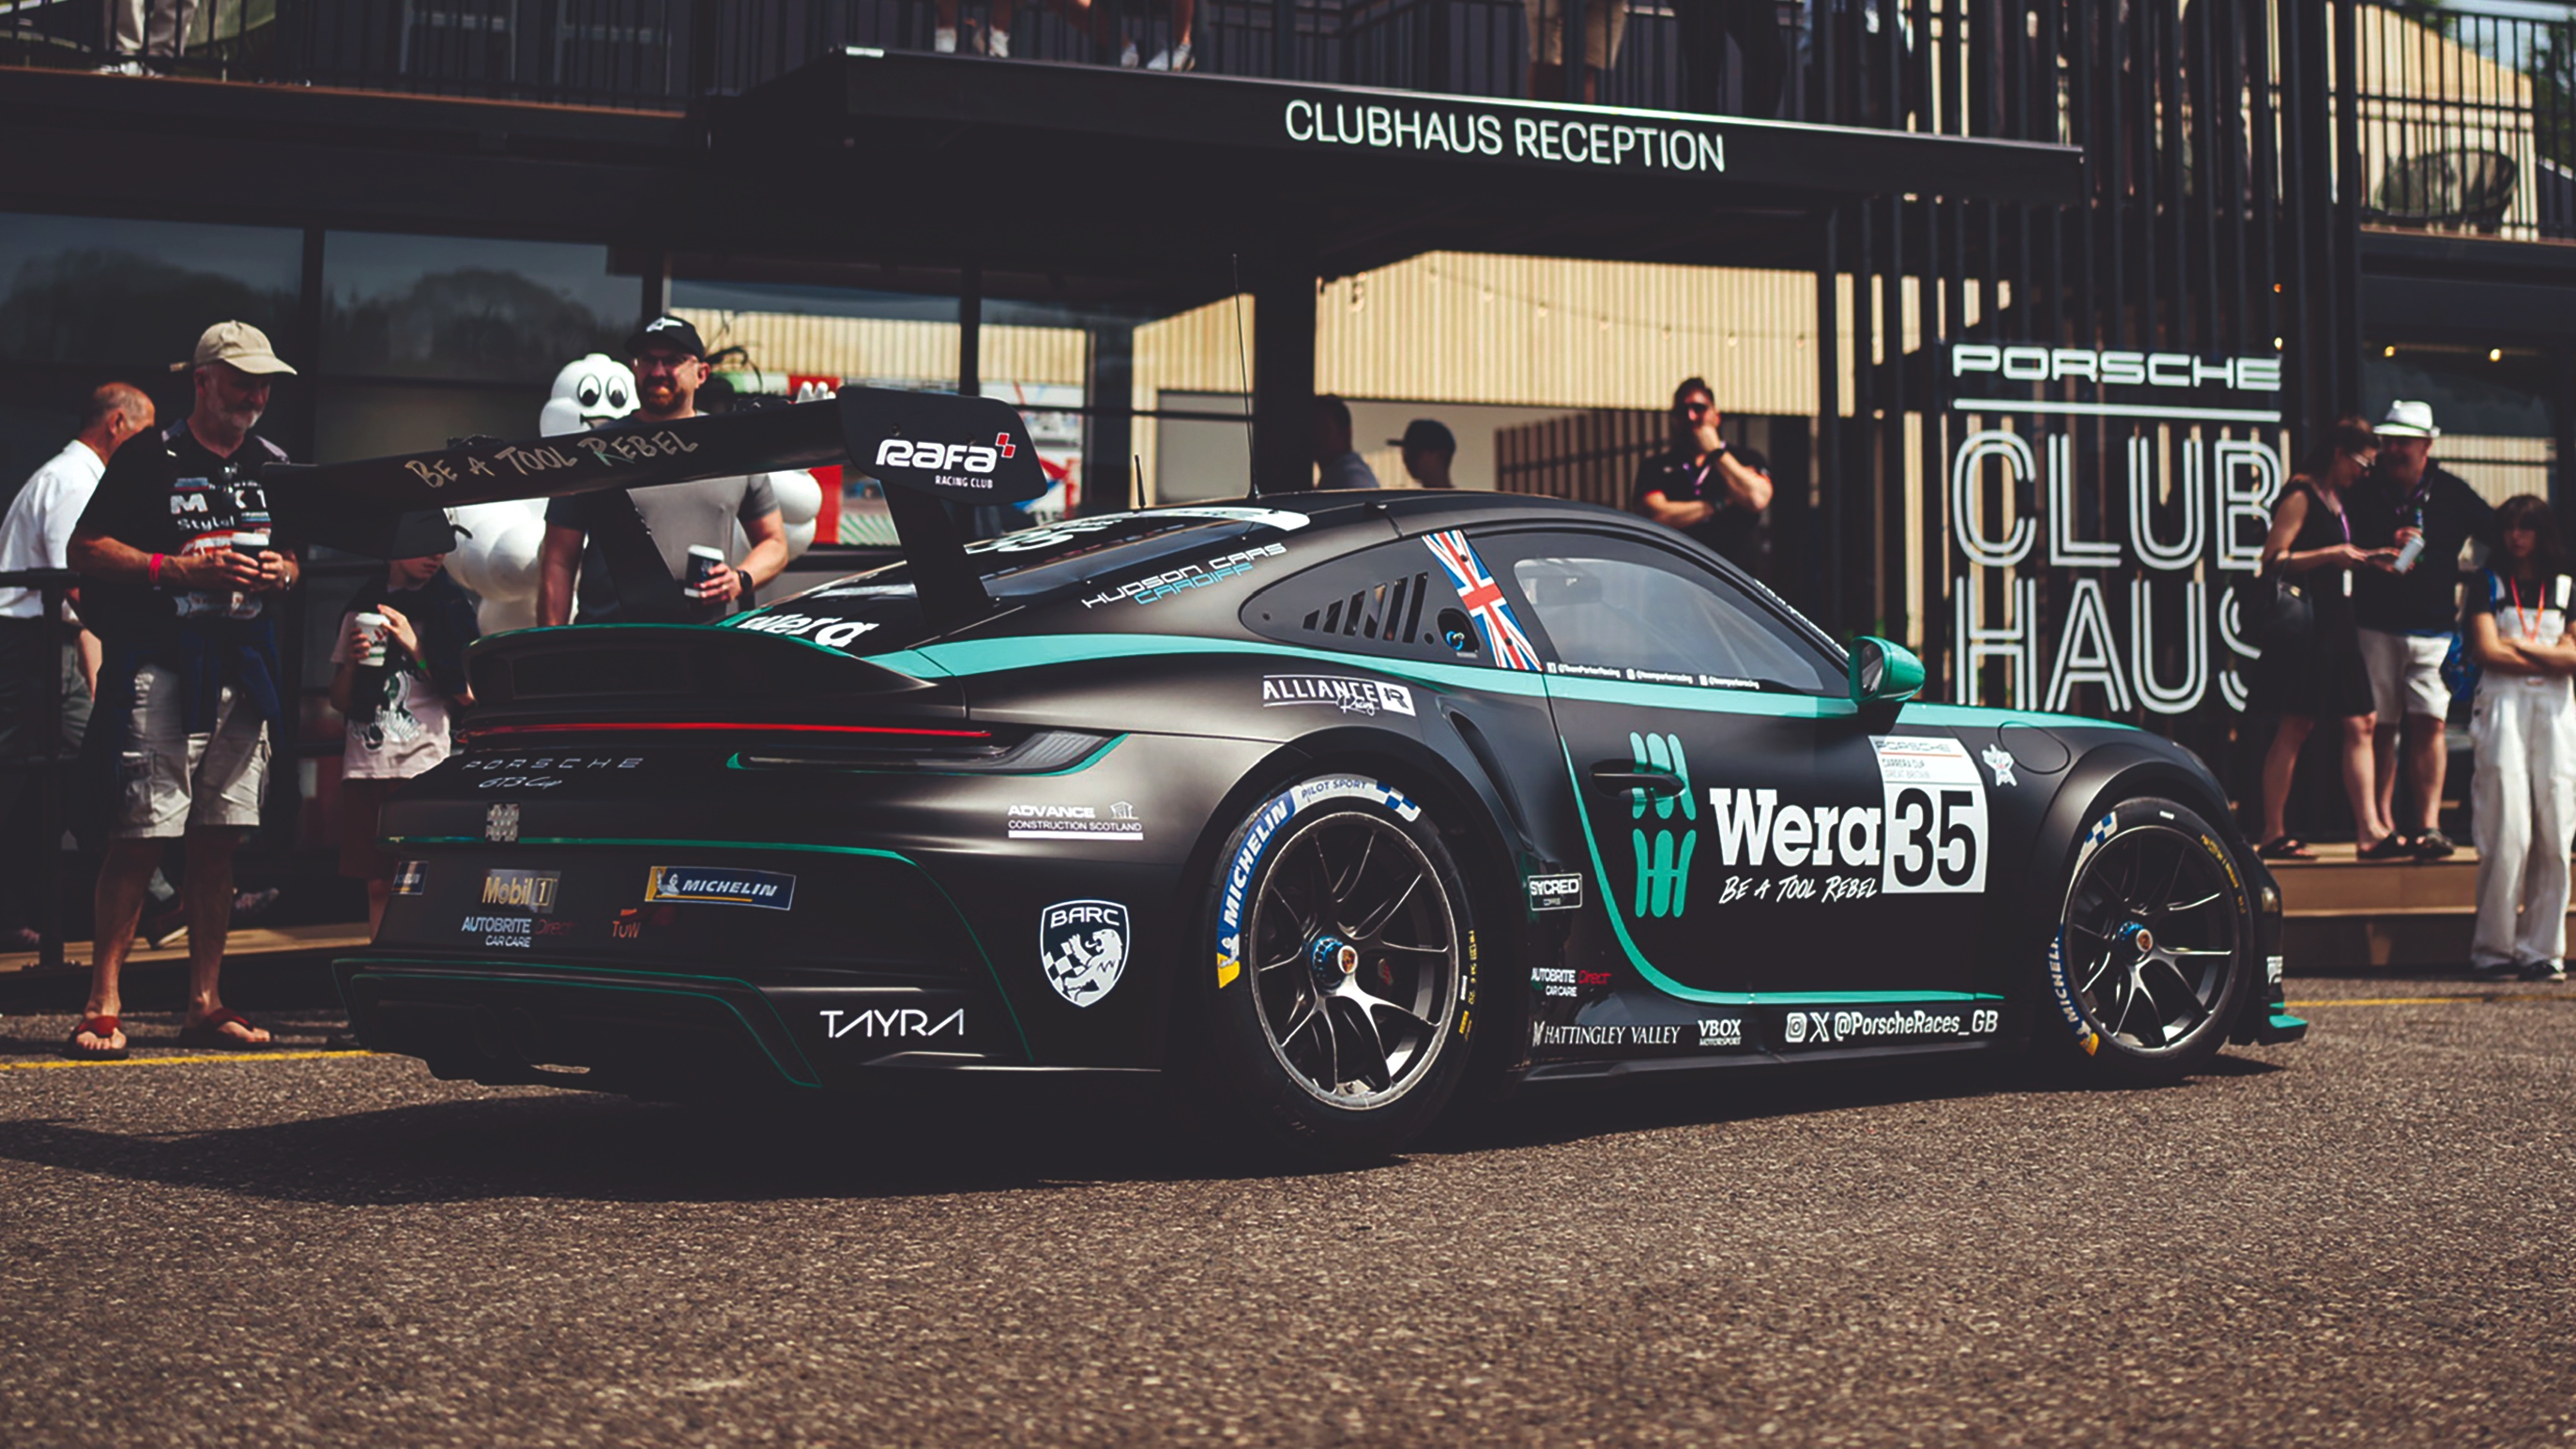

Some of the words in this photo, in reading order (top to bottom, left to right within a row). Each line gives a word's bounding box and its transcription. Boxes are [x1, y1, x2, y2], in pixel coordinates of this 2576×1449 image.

[1286, 99, 1502, 155] CLUBHAUS
[1515, 117, 1725, 173] RECEPTION
[1953, 344, 2281, 390] PORSCHE
[404, 459, 458, 488] BE
[468, 456, 495, 477] A
[495, 446, 577, 476] TOOL
[577, 431, 698, 467] REBEL
[935, 475, 968, 487] RACING
[970, 478, 993, 489] CLUB
[1953, 430, 2282, 571] CLUB
[1081, 564, 1203, 608] HUDSON
[1208, 542, 1288, 569] CARS
[1134, 563, 1254, 604] CARDIFF
[1263, 679, 1379, 702] ALLIANCE
[462, 757, 644, 770] PORSCHE
[1302, 781, 1331, 799] PILOT
[1333, 779, 1367, 789] SPORT
[1008, 805, 1096, 818] ADVANCE
[1008, 819, 1087, 831] CONSTRUCTION
[1090, 821, 1143, 831] SCOTLAND
[1709, 787, 1882, 867] Wera
[1894, 787, 1977, 888] 35
[1223, 800, 1288, 928] MICHELIN
[481, 877, 533, 906] Mobil
[682, 879, 779, 897] MICHELIN
[1718, 875, 1753, 904] BE
[1754, 878, 1771, 897] A
[1776, 874, 1817, 902] TOOL
[1821, 875, 1878, 903] REBEL
[461, 916, 532, 933] AUTOBRITE
[1050, 907, 1120, 928] BARC
[485, 934, 505, 947] CAR
[505, 936, 531, 948] CARE
[1531, 967, 1577, 984] AUTOBRITE
[1578, 969, 1612, 984] Direct
[2048, 937, 2080, 1023] MICHELI
[819, 1008, 964, 1038] TAYRA
[1545, 1026, 1626, 1045] HATTINGLEY
[1631, 1026, 1681, 1045] VALLEY
[1697, 1018, 1743, 1037] VBOX
[1834, 1009, 1999, 1042] @PorscheRaces_GB
